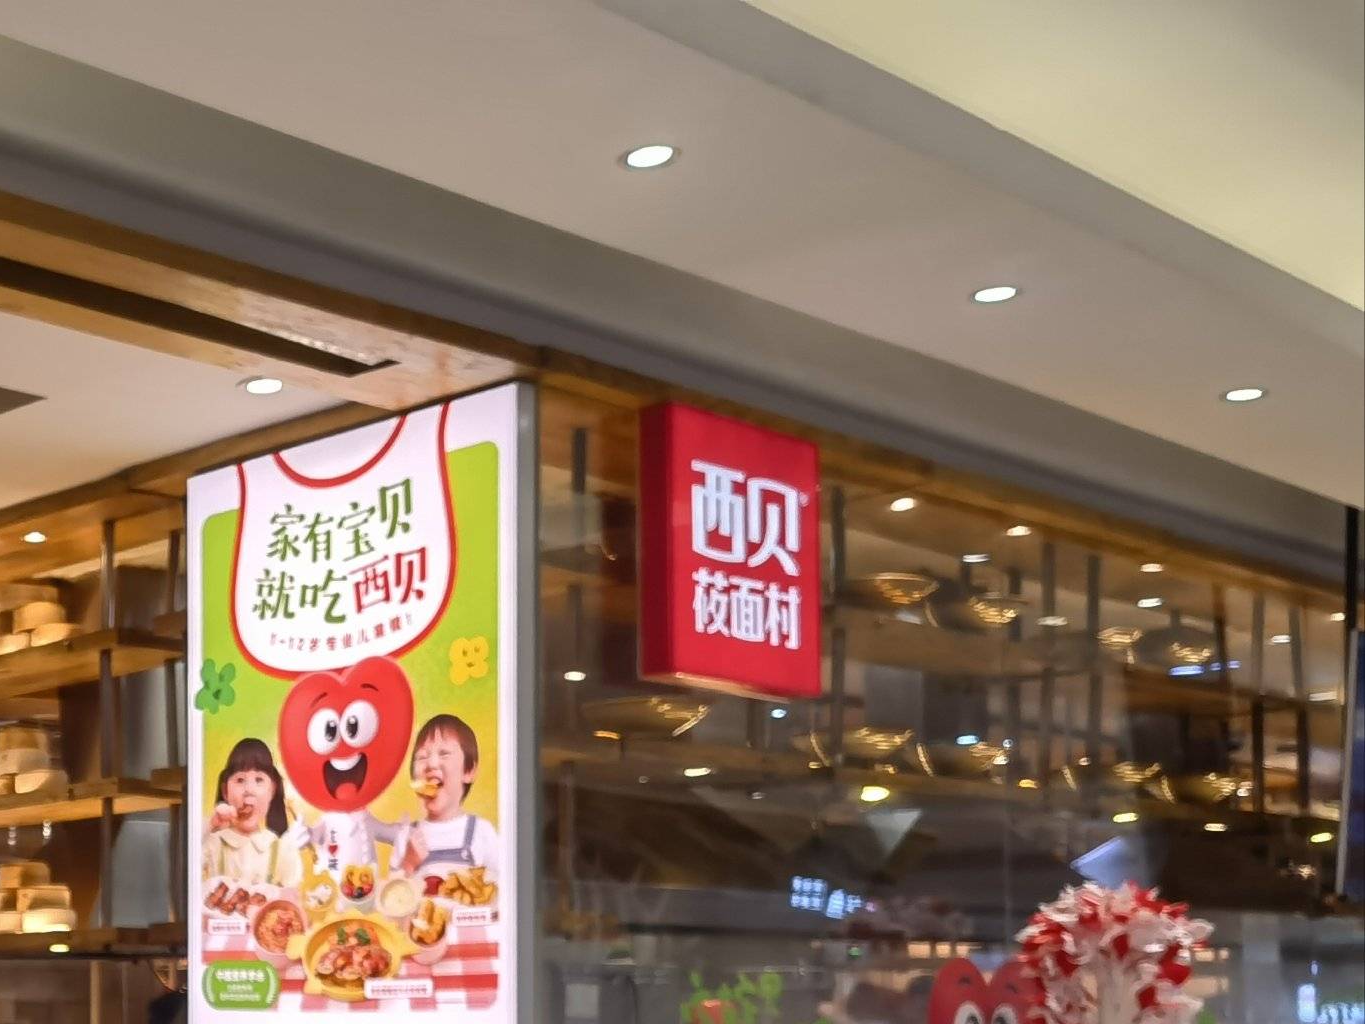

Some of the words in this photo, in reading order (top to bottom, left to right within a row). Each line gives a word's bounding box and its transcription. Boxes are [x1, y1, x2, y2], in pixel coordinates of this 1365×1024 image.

[266, 478, 412, 564] 家有宝贝
[690, 457, 802, 577] 西贝
[252, 546, 427, 624] 就吃西贝
[691, 566, 802, 651] 莜面村
